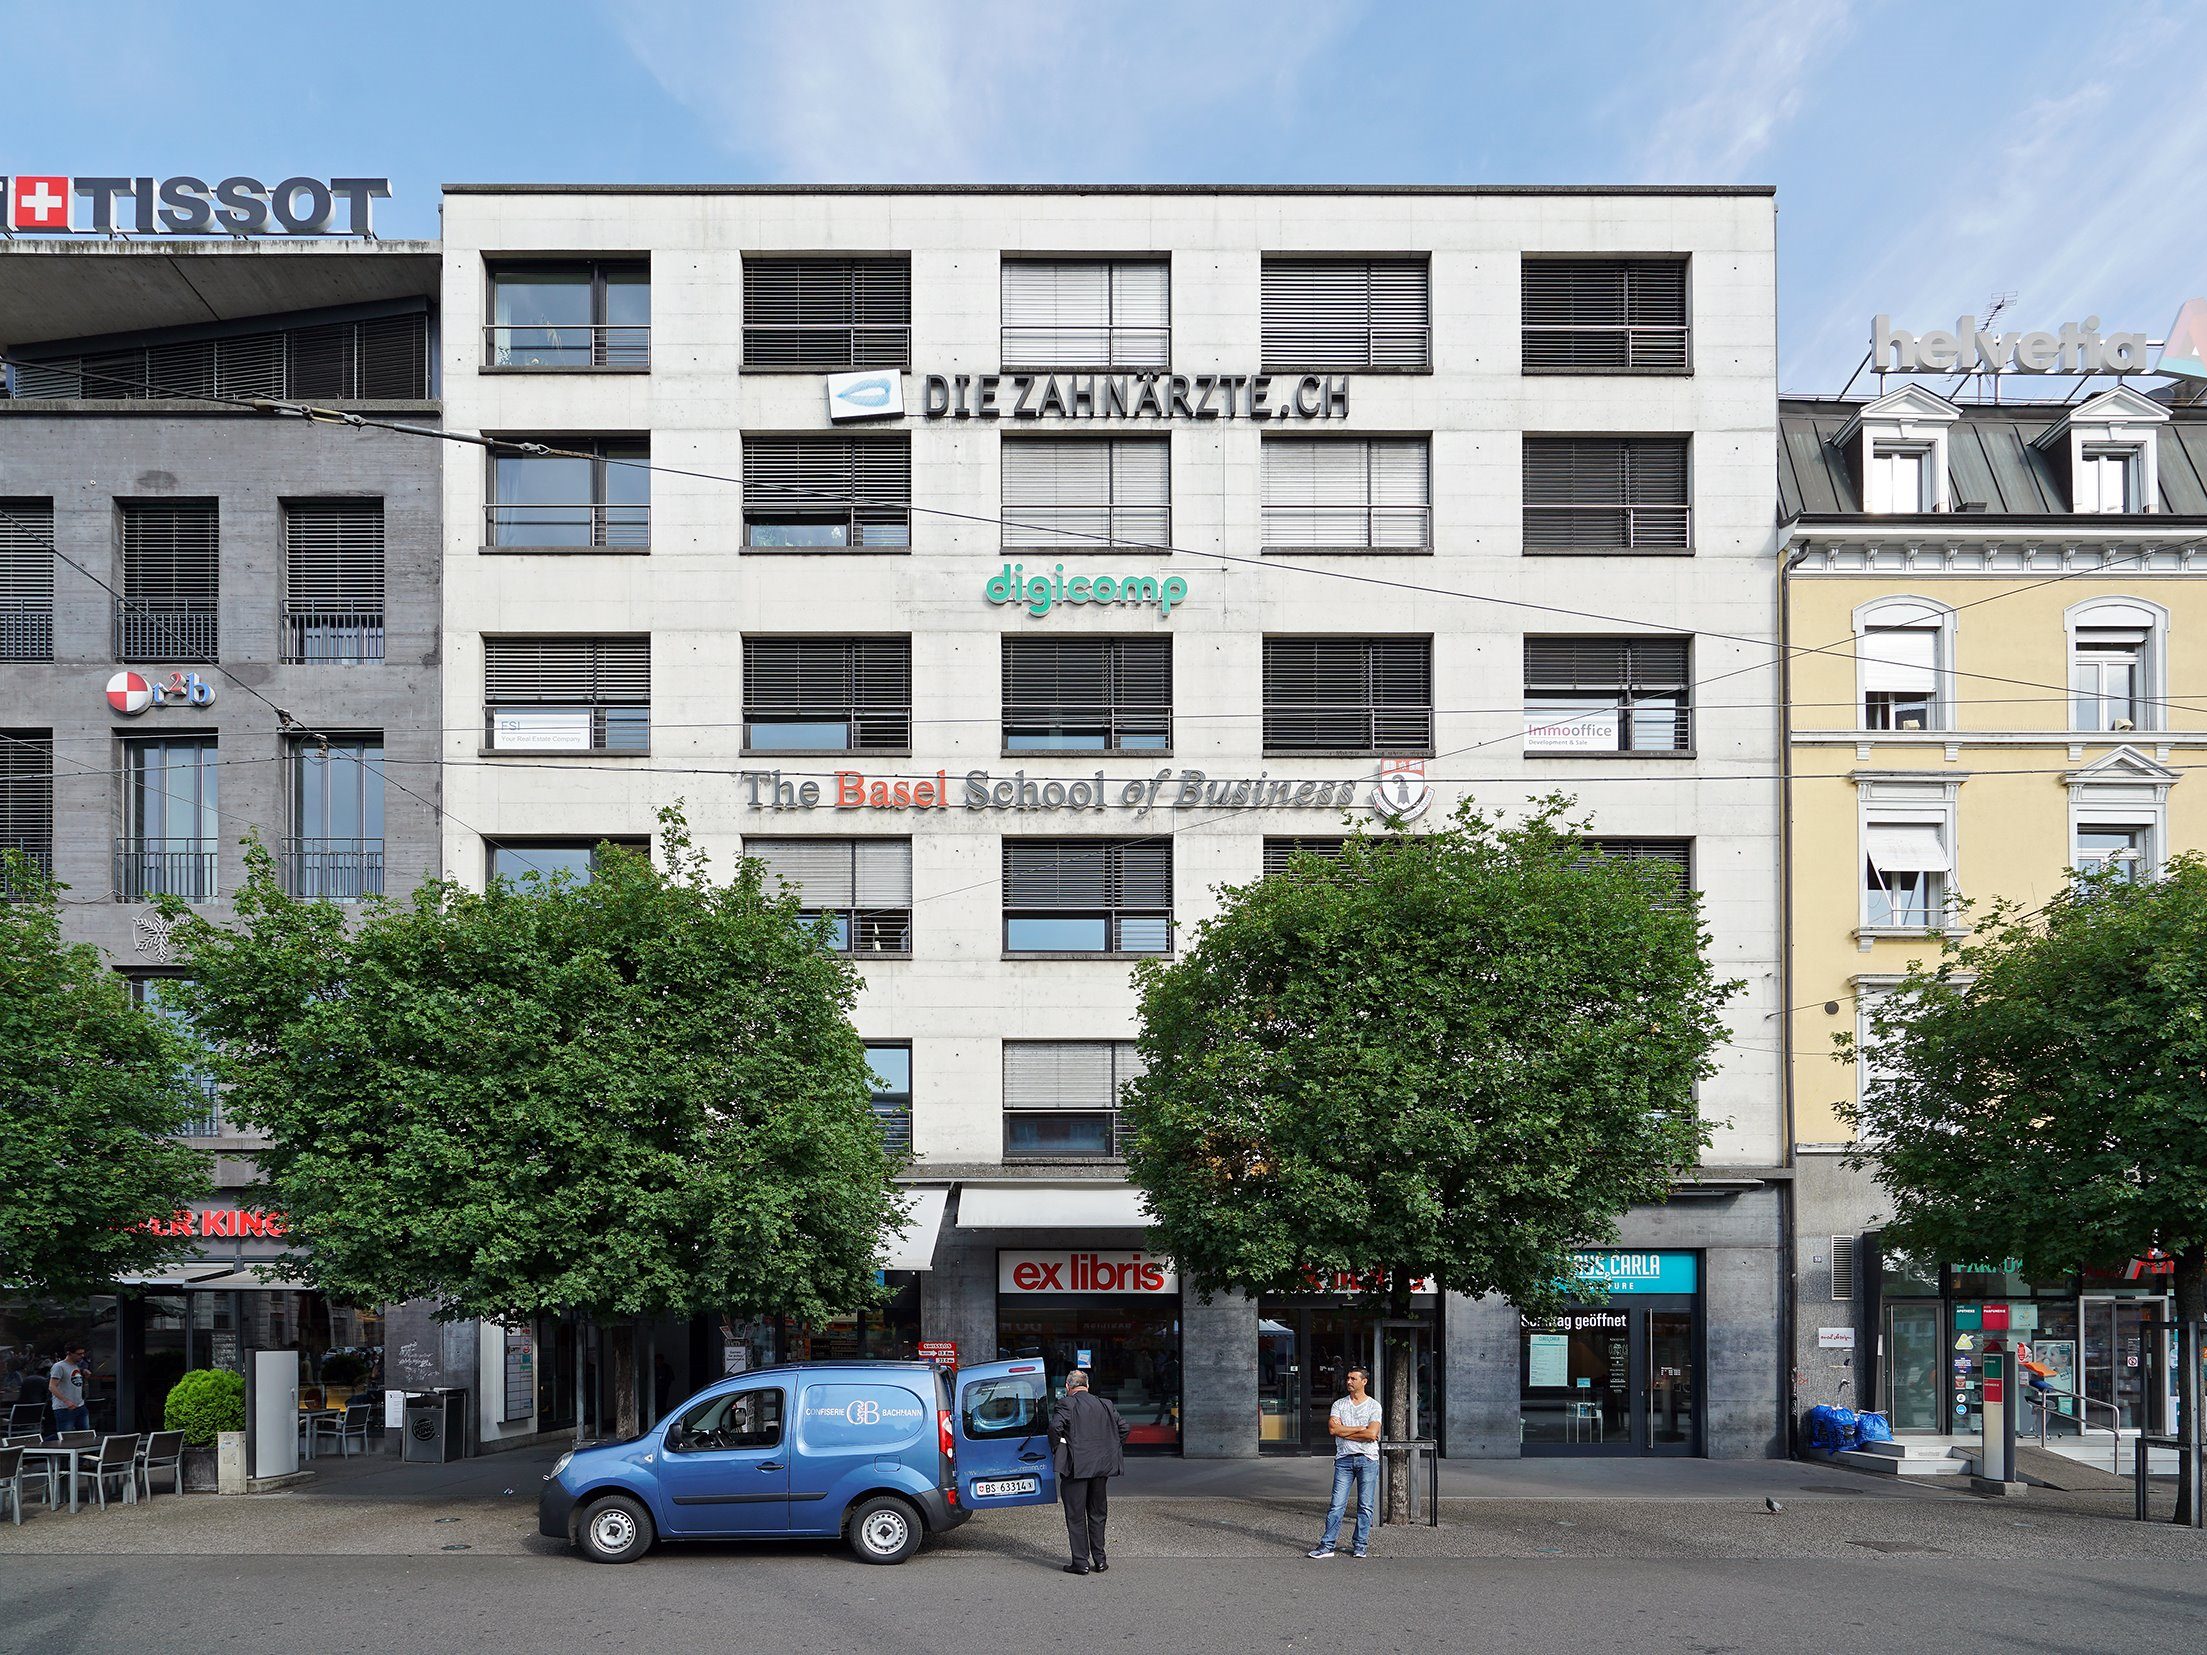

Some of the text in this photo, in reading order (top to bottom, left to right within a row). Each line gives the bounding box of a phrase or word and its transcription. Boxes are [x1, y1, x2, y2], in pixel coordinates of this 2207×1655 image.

[74, 176, 391, 235] TISSOT
[1871, 313, 2147, 375] helvetia
[986, 563, 1189, 617] digicomp
[552, 735, 581, 743] Company
[1528, 723, 1612, 737] Immooffice
[741, 769, 820, 808] The
[834, 769, 950, 810] Basel
[965, 769, 1108, 809] School
[1121, 768, 1173, 815] of
[1174, 769, 1358, 807] Business
[1013, 1253, 1165, 1291] ex libris
[1610, 1254, 1661, 1276] CARLA
[1575, 1312, 1627, 1330] geöffnet
[805, 1408, 845, 1416] CONFISERIE
[882, 1408, 922, 1417] BACHMANN
[985, 1483, 996, 1494] BS
[1000, 1481, 1027, 1492] 63314
